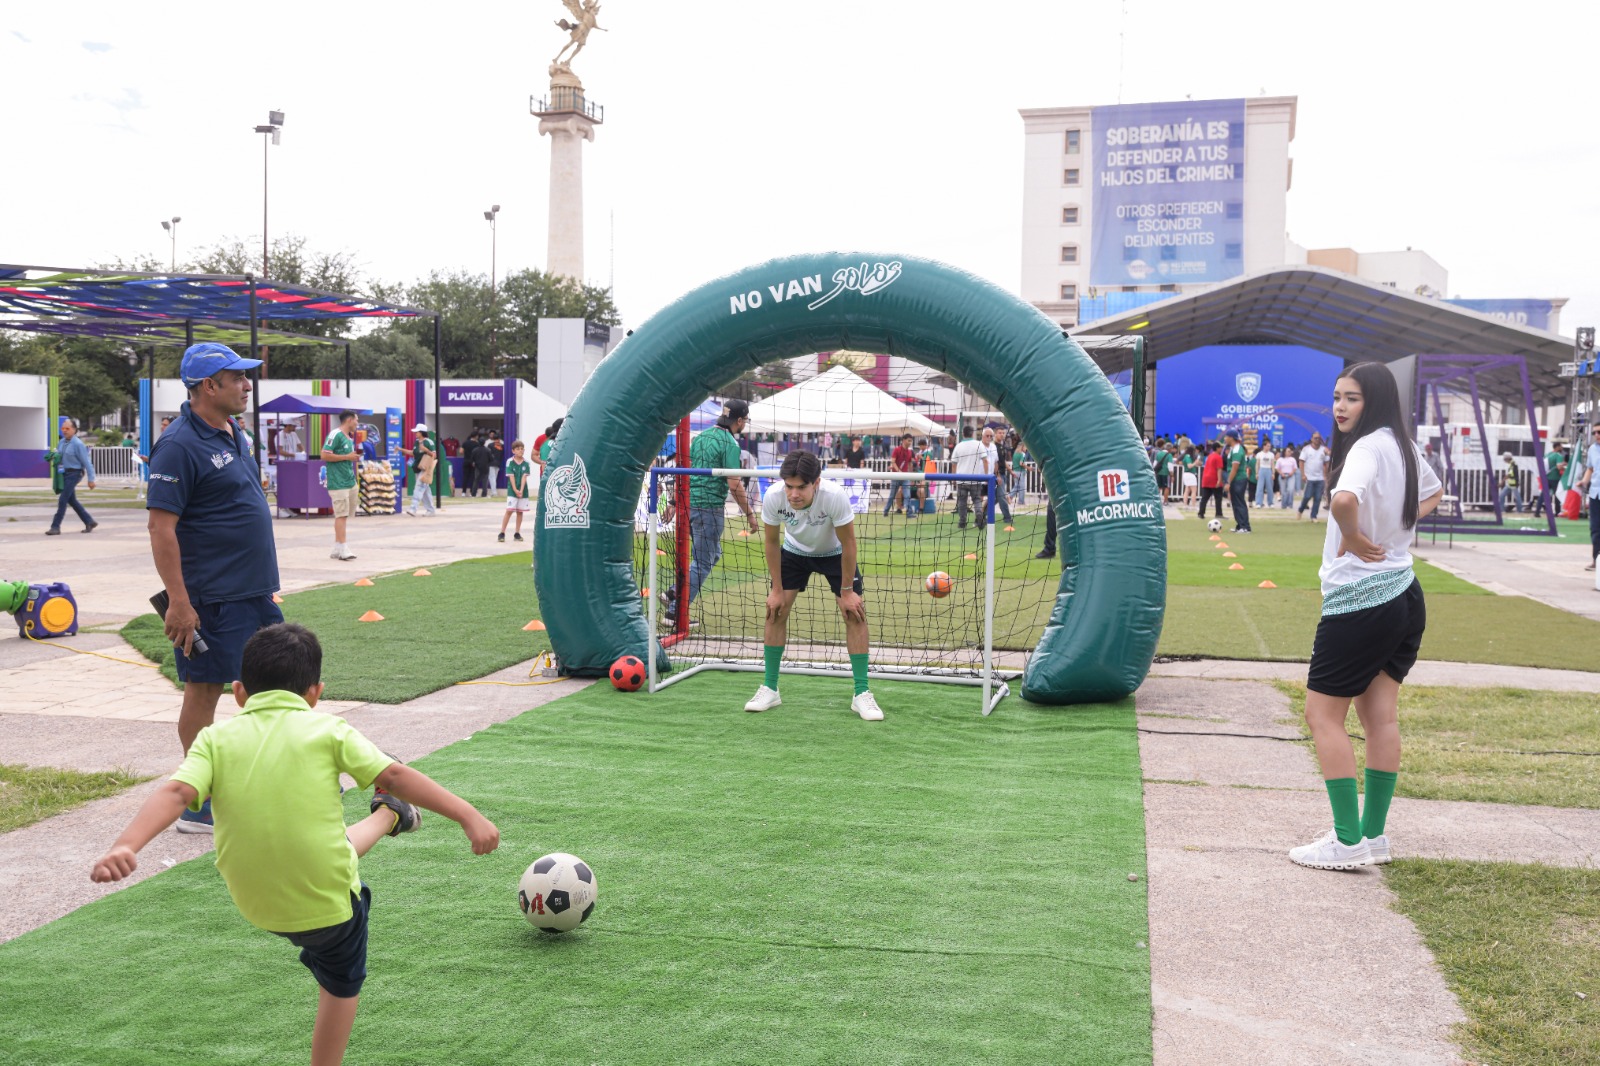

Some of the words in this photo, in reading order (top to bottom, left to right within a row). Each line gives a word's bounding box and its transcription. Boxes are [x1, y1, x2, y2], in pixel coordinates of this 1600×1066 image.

[1106, 118, 1204, 146] SOBERANÍA
[1207, 121, 1229, 140] ES
[1107, 147, 1182, 167] DEFENDER
[1184, 147, 1196, 162] A
[1198, 145, 1228, 161] TUS
[1101, 169, 1144, 187] HIJOS
[1146, 167, 1174, 184] DEL
[1176, 164, 1234, 182] CRIMEN
[1116, 204, 1156, 218] OTROS
[1157, 201, 1223, 216] PREFIEREN
[1137, 218, 1202, 232] ESCONDER
[1125, 232, 1214, 247] DELINCUENTES
[729, 290, 763, 315] NO
[768, 274, 823, 303] VAN
[448, 392, 494, 401] PLAYERAS
[1220, 404, 1275, 414] GOBIERNO
[547, 513, 585, 524] MÉXICO
